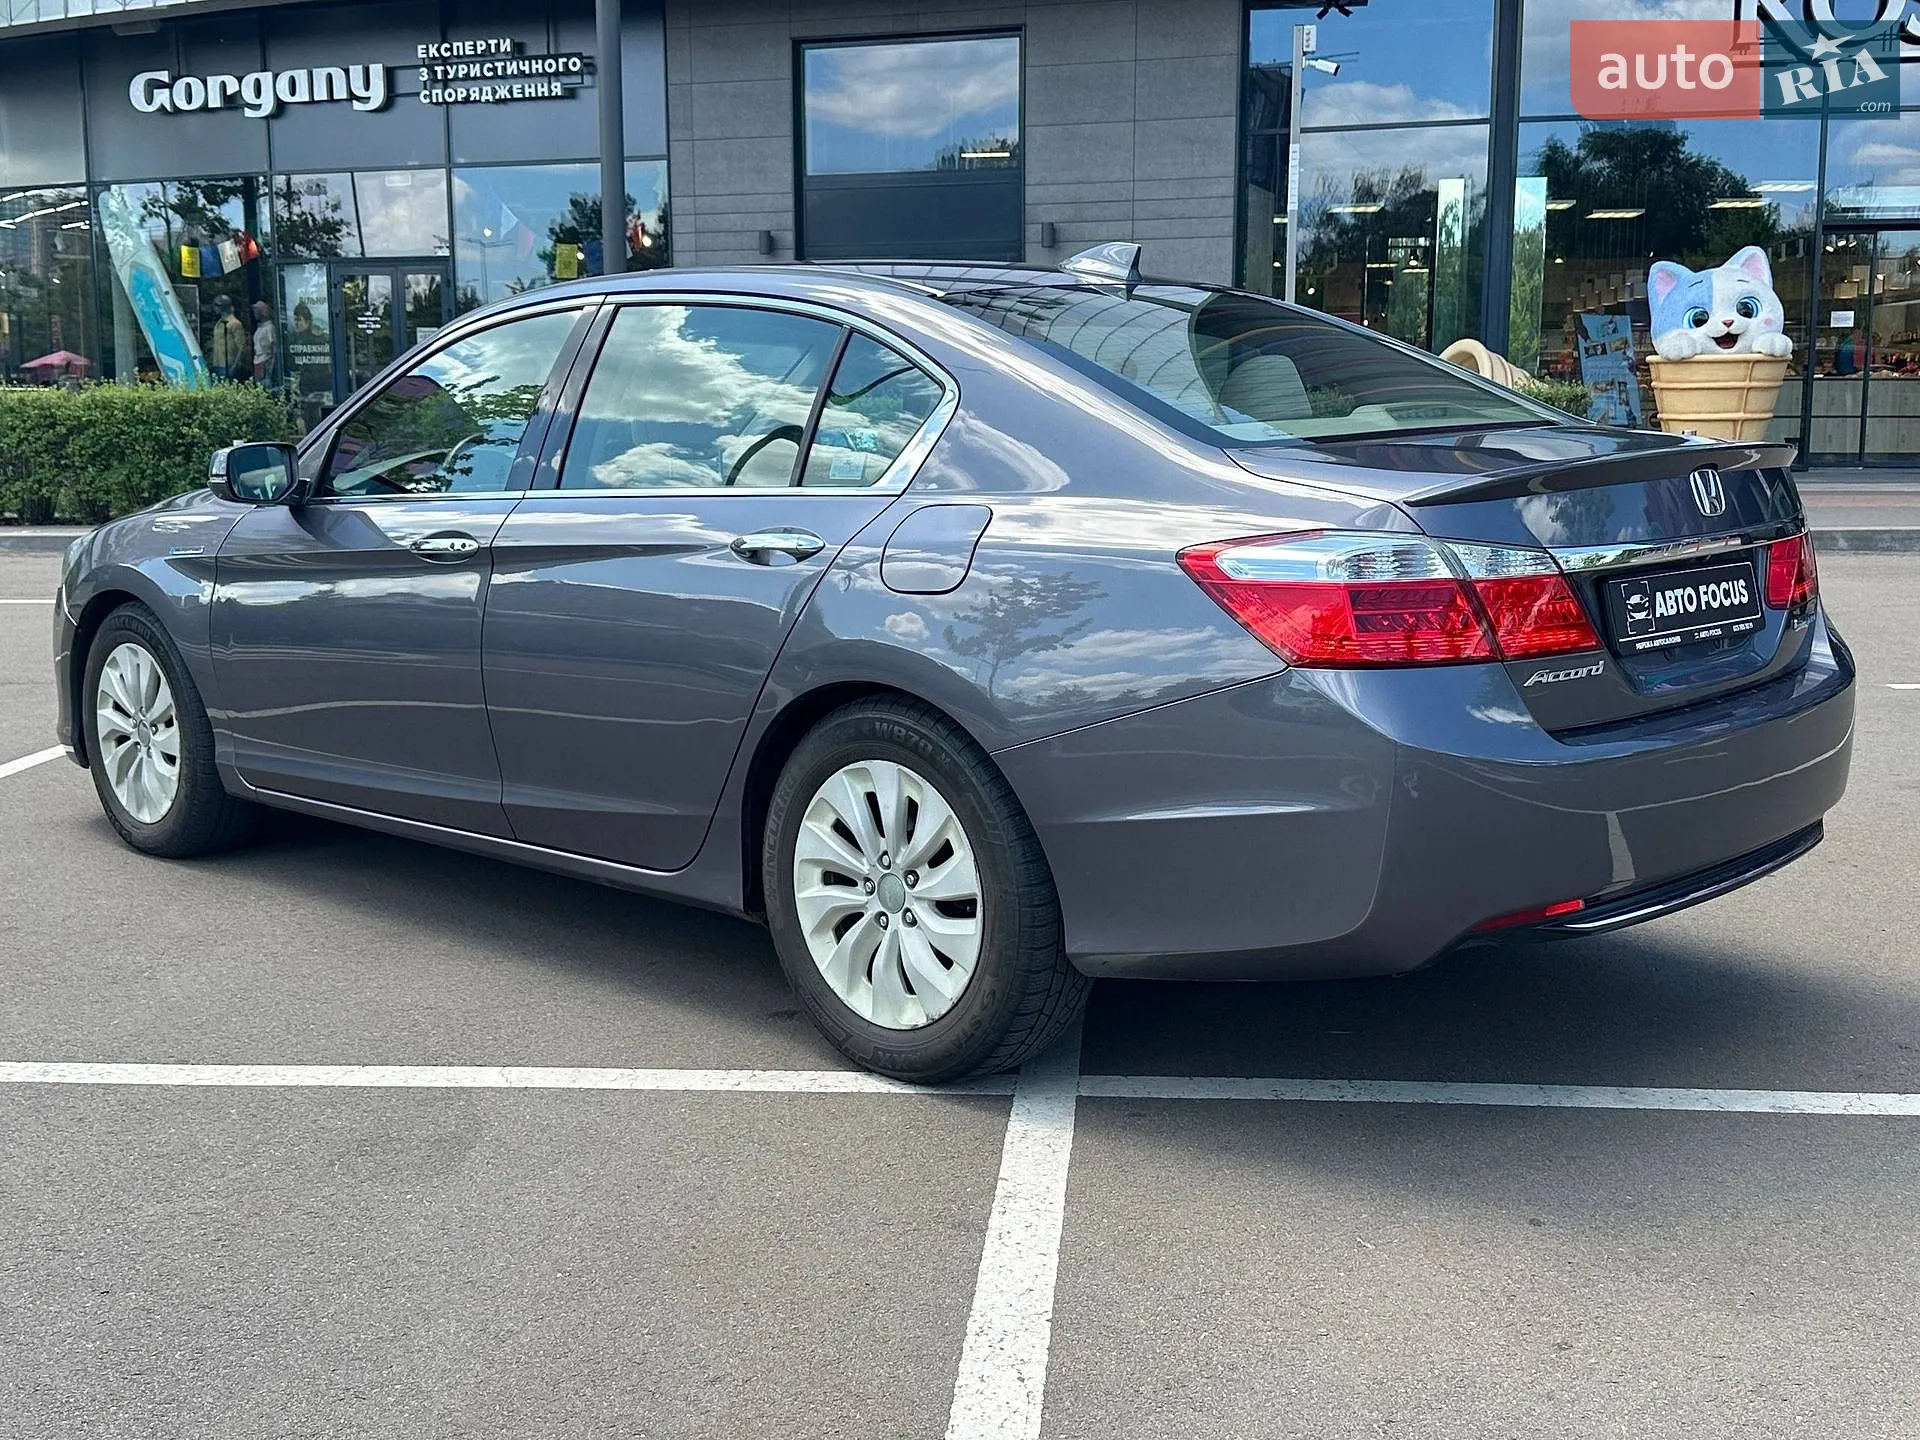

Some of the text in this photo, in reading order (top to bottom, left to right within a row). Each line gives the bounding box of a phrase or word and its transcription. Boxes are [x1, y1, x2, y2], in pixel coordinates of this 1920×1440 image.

[417, 38, 512, 59] ЕКСПЕРТИ
[434, 57, 582, 80] ТУРИСТИЧНОГО
[129, 63, 385, 118] Gorgany
[419, 82, 563, 104] СПОРЯДЖЕННЯ
[1655, 578, 1749, 618] АВТО FOCUS
[1523, 660, 1605, 687] Accord
